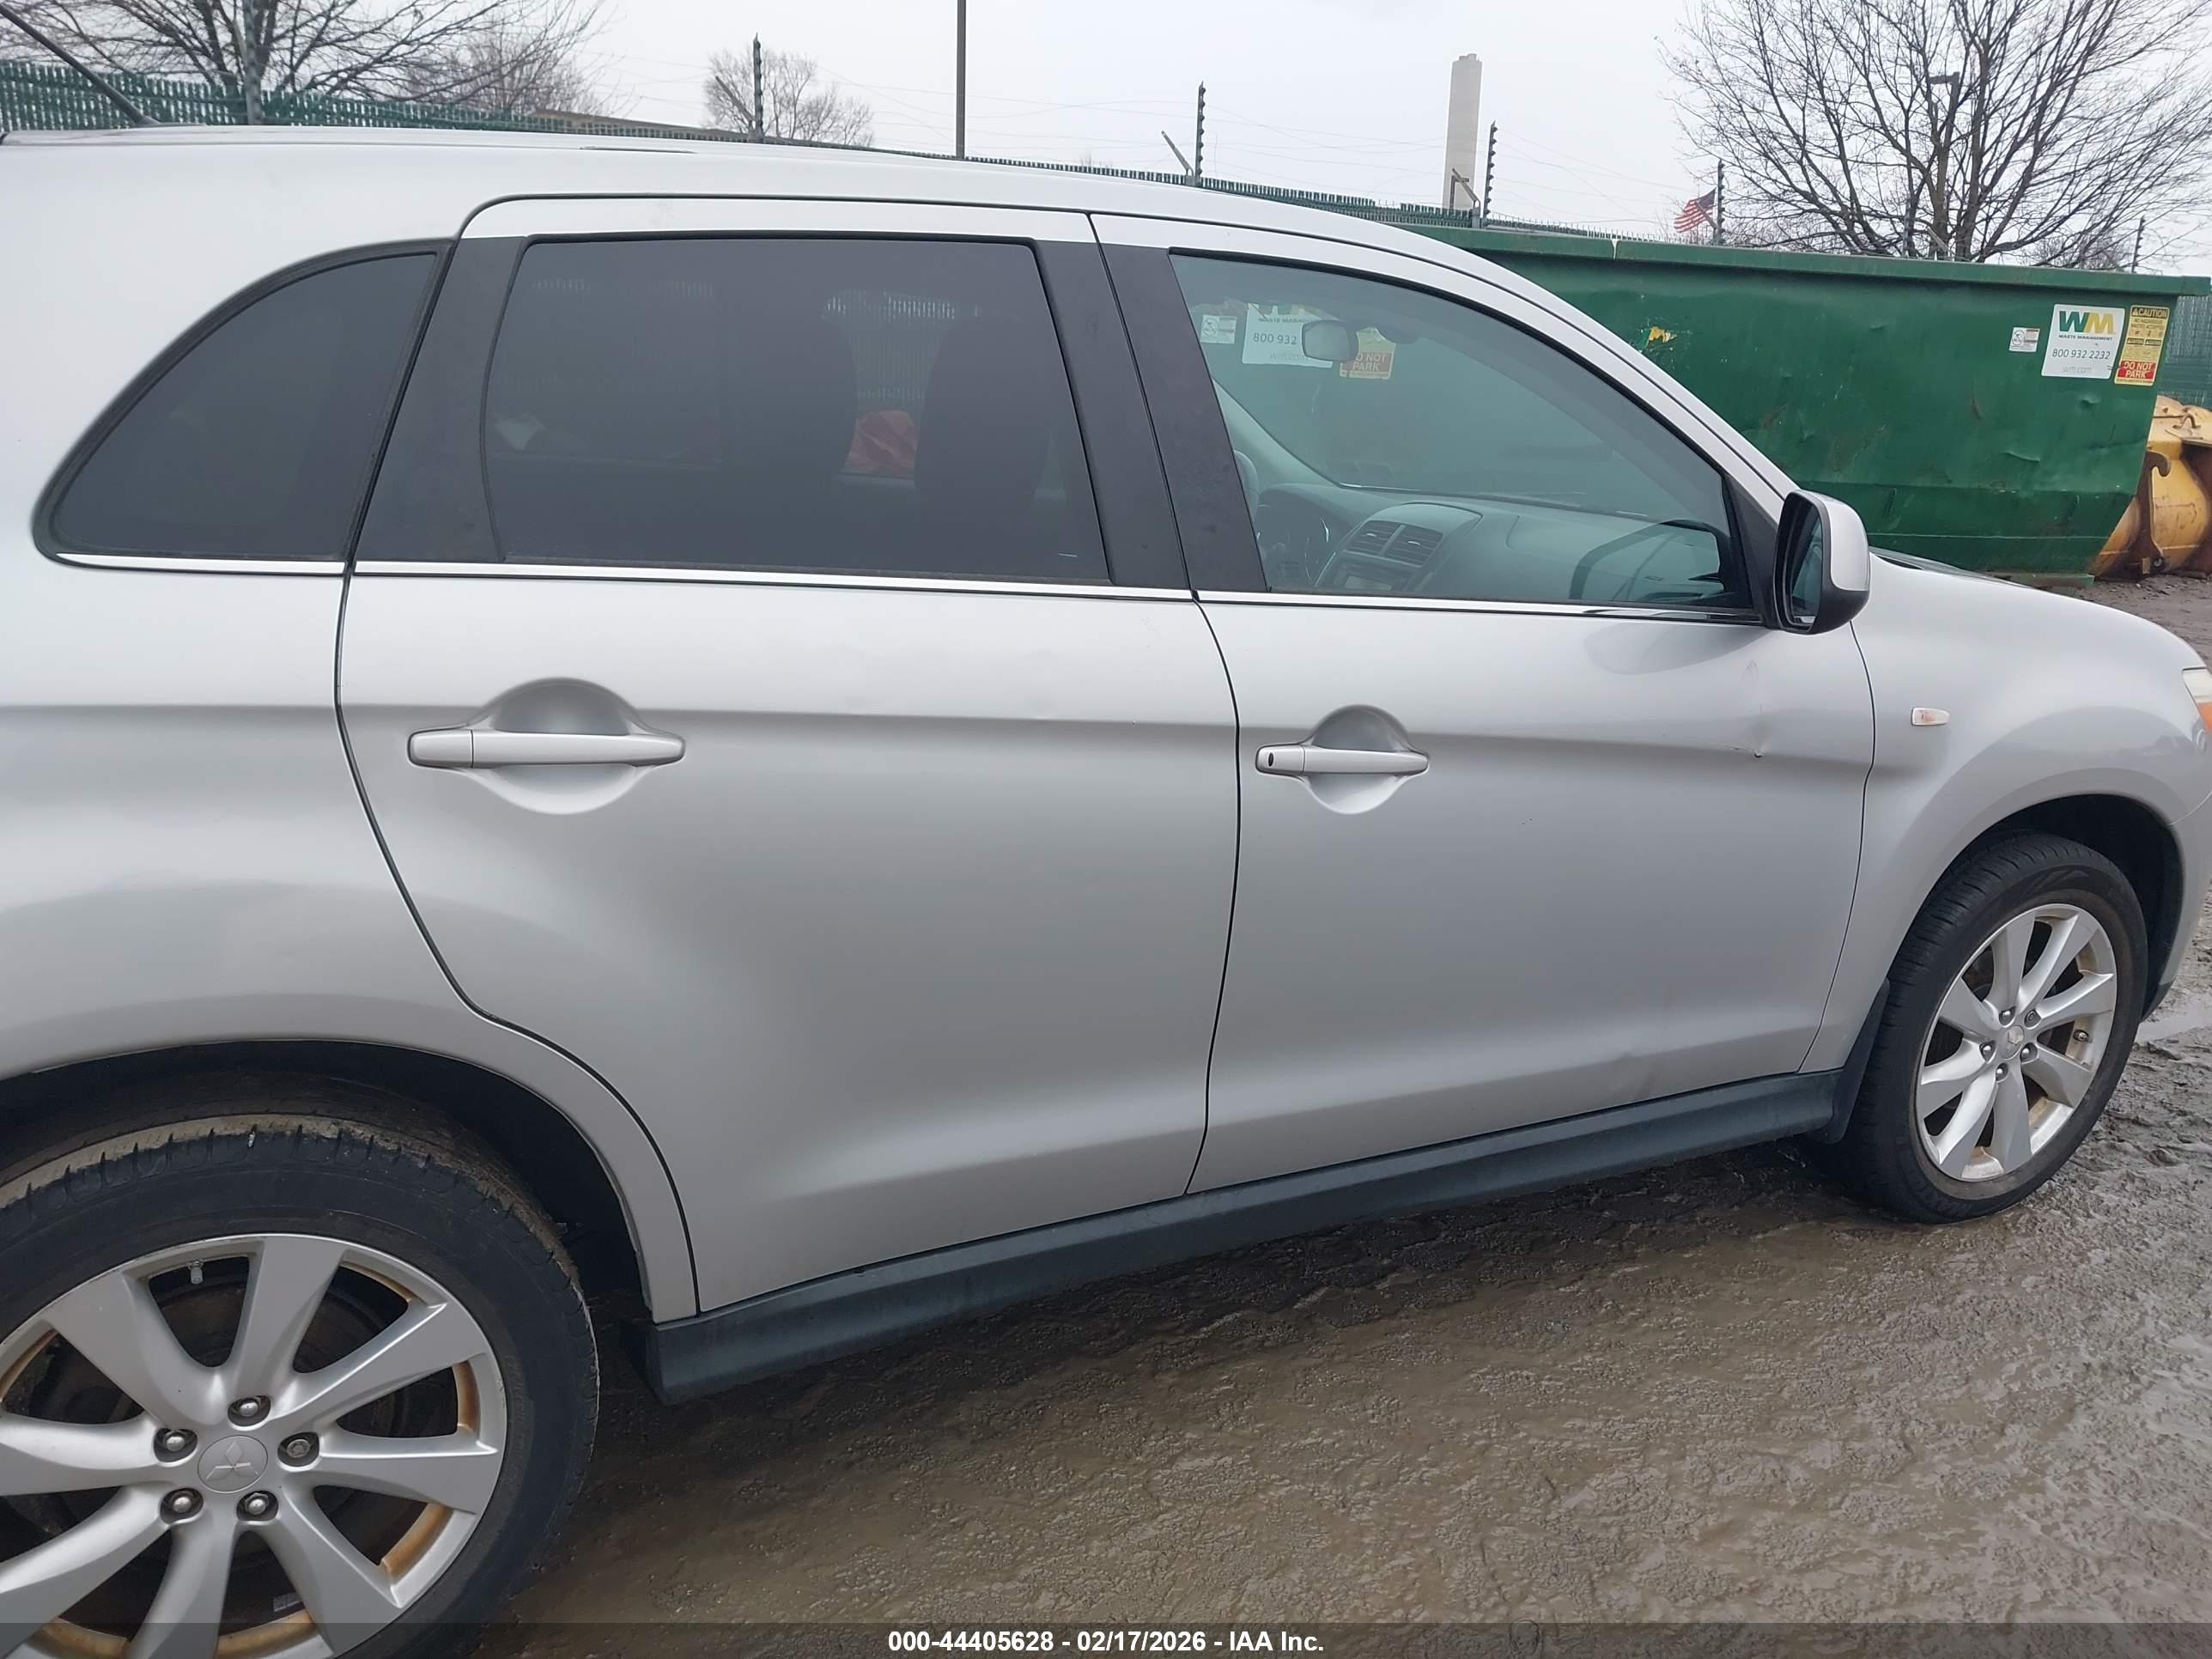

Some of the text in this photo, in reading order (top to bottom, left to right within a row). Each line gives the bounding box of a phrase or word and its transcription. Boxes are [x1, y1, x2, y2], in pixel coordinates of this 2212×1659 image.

[2138, 308, 2166, 318] CAUTION
[2059, 311, 2116, 334] WM
[1254, 332, 1297, 345] 800 932
[1366, 353, 1387, 362] NOT
[2052, 349, 2111, 360] 800 932 2232
[1352, 362, 1380, 372] PARK
[2137, 362, 2153, 371] NOT
[2125, 370, 2148, 379] PARK
